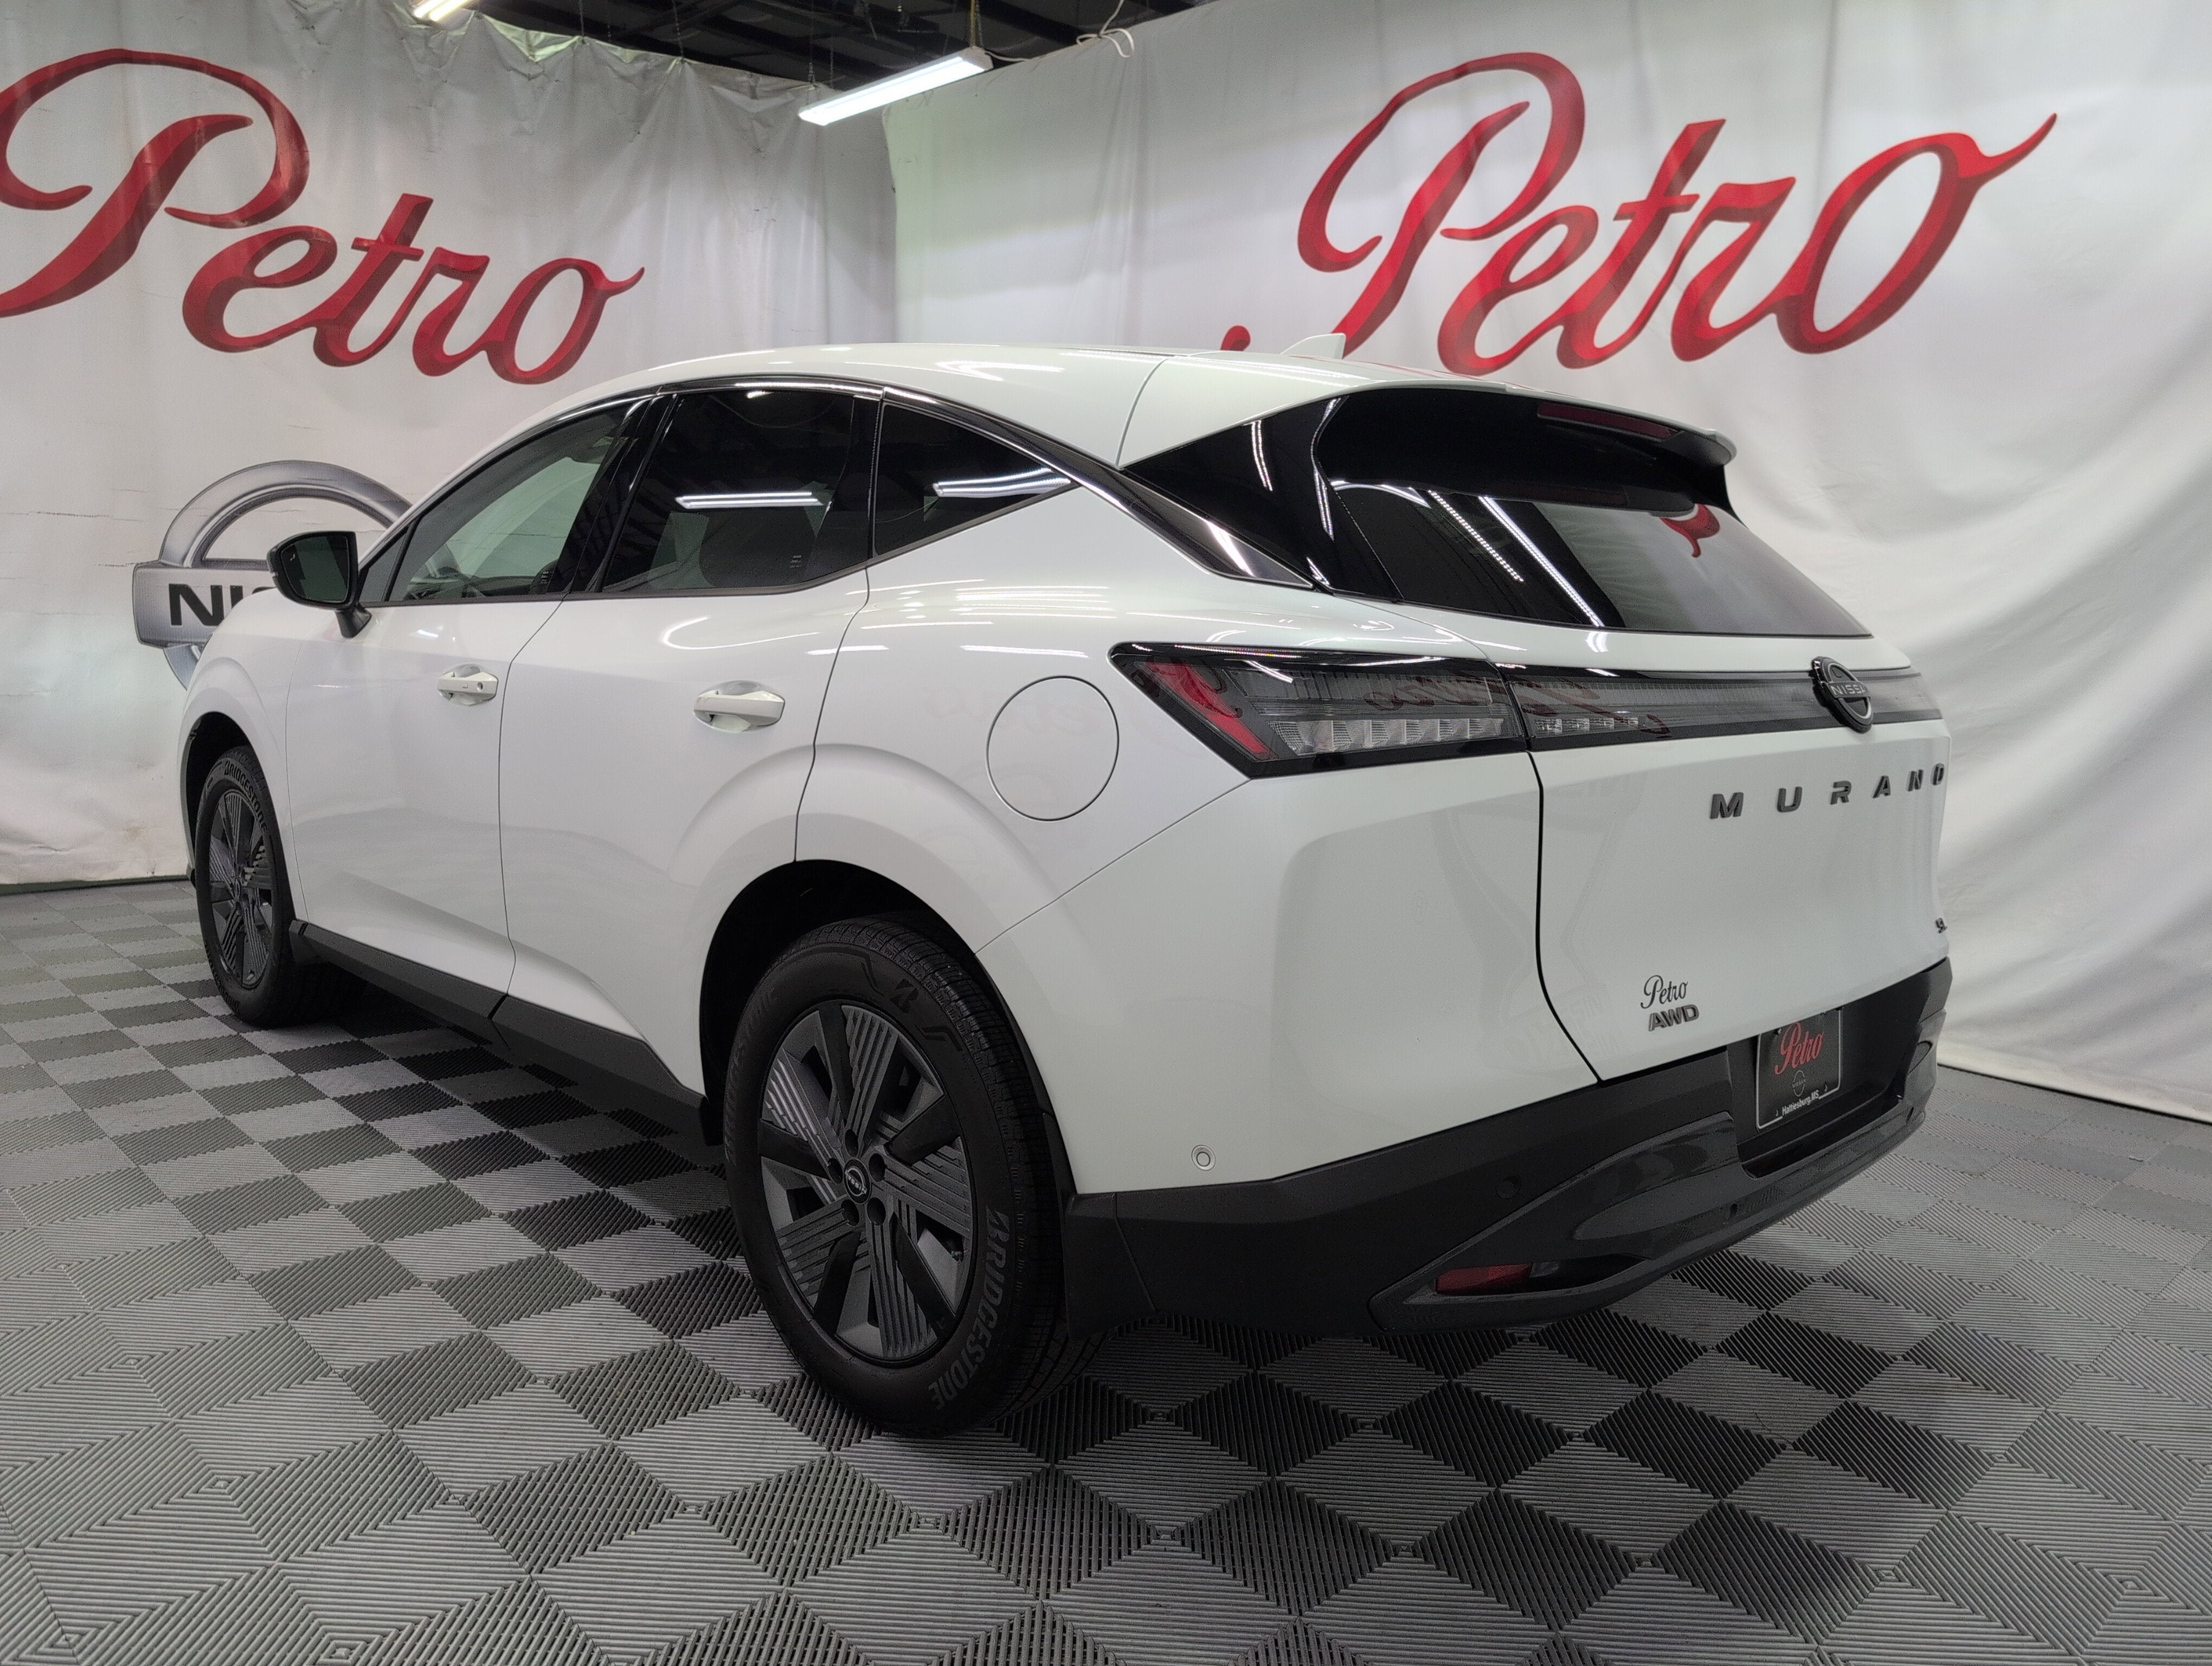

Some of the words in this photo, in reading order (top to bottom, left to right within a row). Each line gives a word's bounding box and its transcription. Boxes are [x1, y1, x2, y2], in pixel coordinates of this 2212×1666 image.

[0, 48, 644, 384] Petro
[1221, 52, 2056, 375] Petro
[1710, 763, 1945, 819] MURANO
[1640, 975, 1689, 1009] Petro
[1648, 1004, 1700, 1031] AWD
[1774, 1021, 1825, 1075] Petro
[929, 1205, 1009, 1409] BRIDGESTONE
